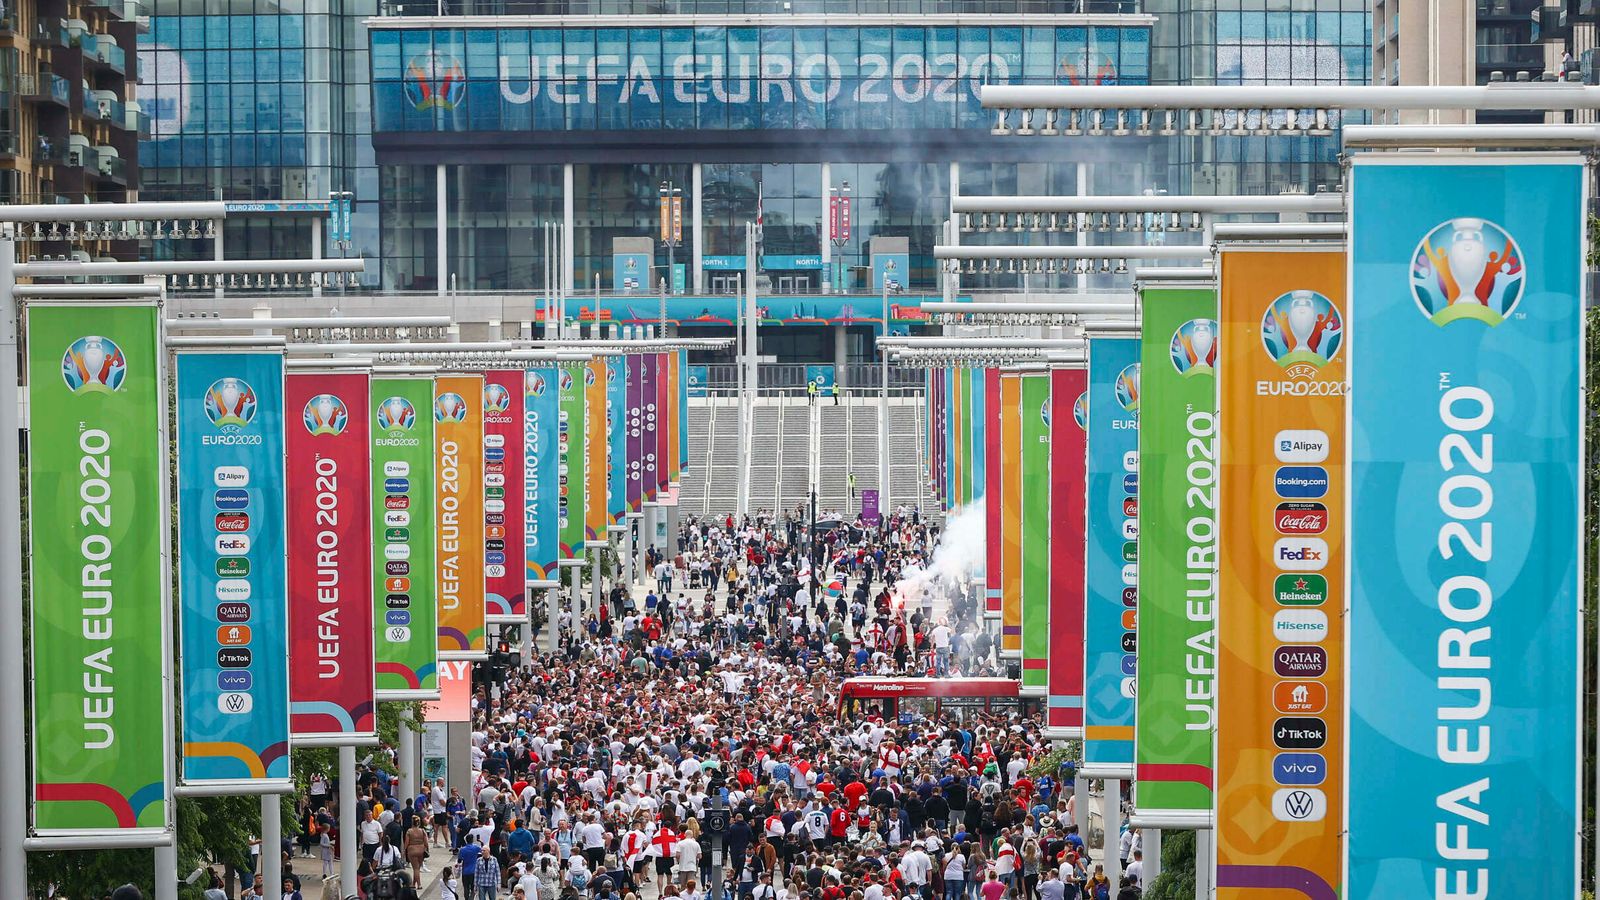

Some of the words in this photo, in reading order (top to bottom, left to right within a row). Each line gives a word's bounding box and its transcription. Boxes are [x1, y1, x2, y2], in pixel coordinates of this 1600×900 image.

[499, 54, 660, 104] UEFA
[672, 54, 841, 103] EURO
[853, 53, 1010, 103] 2020
[1287, 367, 1316, 378] UEFA
[202, 435, 262, 445] EURO2020
[526, 410, 538, 452] 2020
[1293, 442, 1322, 452] Alipay
[80, 429, 112, 528] 2020
[441, 440, 458, 494] 2020
[526, 456, 538, 501] EURO
[1186, 412, 1216, 509] 2020
[1277, 478, 1326, 487] Booking.com
[1438, 386, 1494, 562] 2020
[316, 458, 338, 526] 2020
[442, 498, 459, 552] EURO
[525, 504, 538, 547] UEFA
[316, 530, 339, 604] EURO
[1186, 516, 1216, 622] EURO
[1280, 548, 1321, 560] FedEx
[82, 534, 113, 640] EURO
[442, 556, 460, 610] UEFA
[1280, 592, 1322, 600] Heineken
[220, 607, 247, 615] QATAR
[1277, 621, 1324, 630] Hisense
[317, 608, 340, 680] UEFA
[1279, 652, 1321, 665] QATAR
[1185, 628, 1214, 731] UEFA
[1437, 575, 1492, 764] EURO
[84, 646, 114, 749] UEFA
[1288, 730, 1322, 739] TikTok
[1282, 763, 1316, 773] vivo
[815, 817, 820, 827] 8
[840, 812, 845, 821] 6
[1435, 777, 1490, 900] EFA
